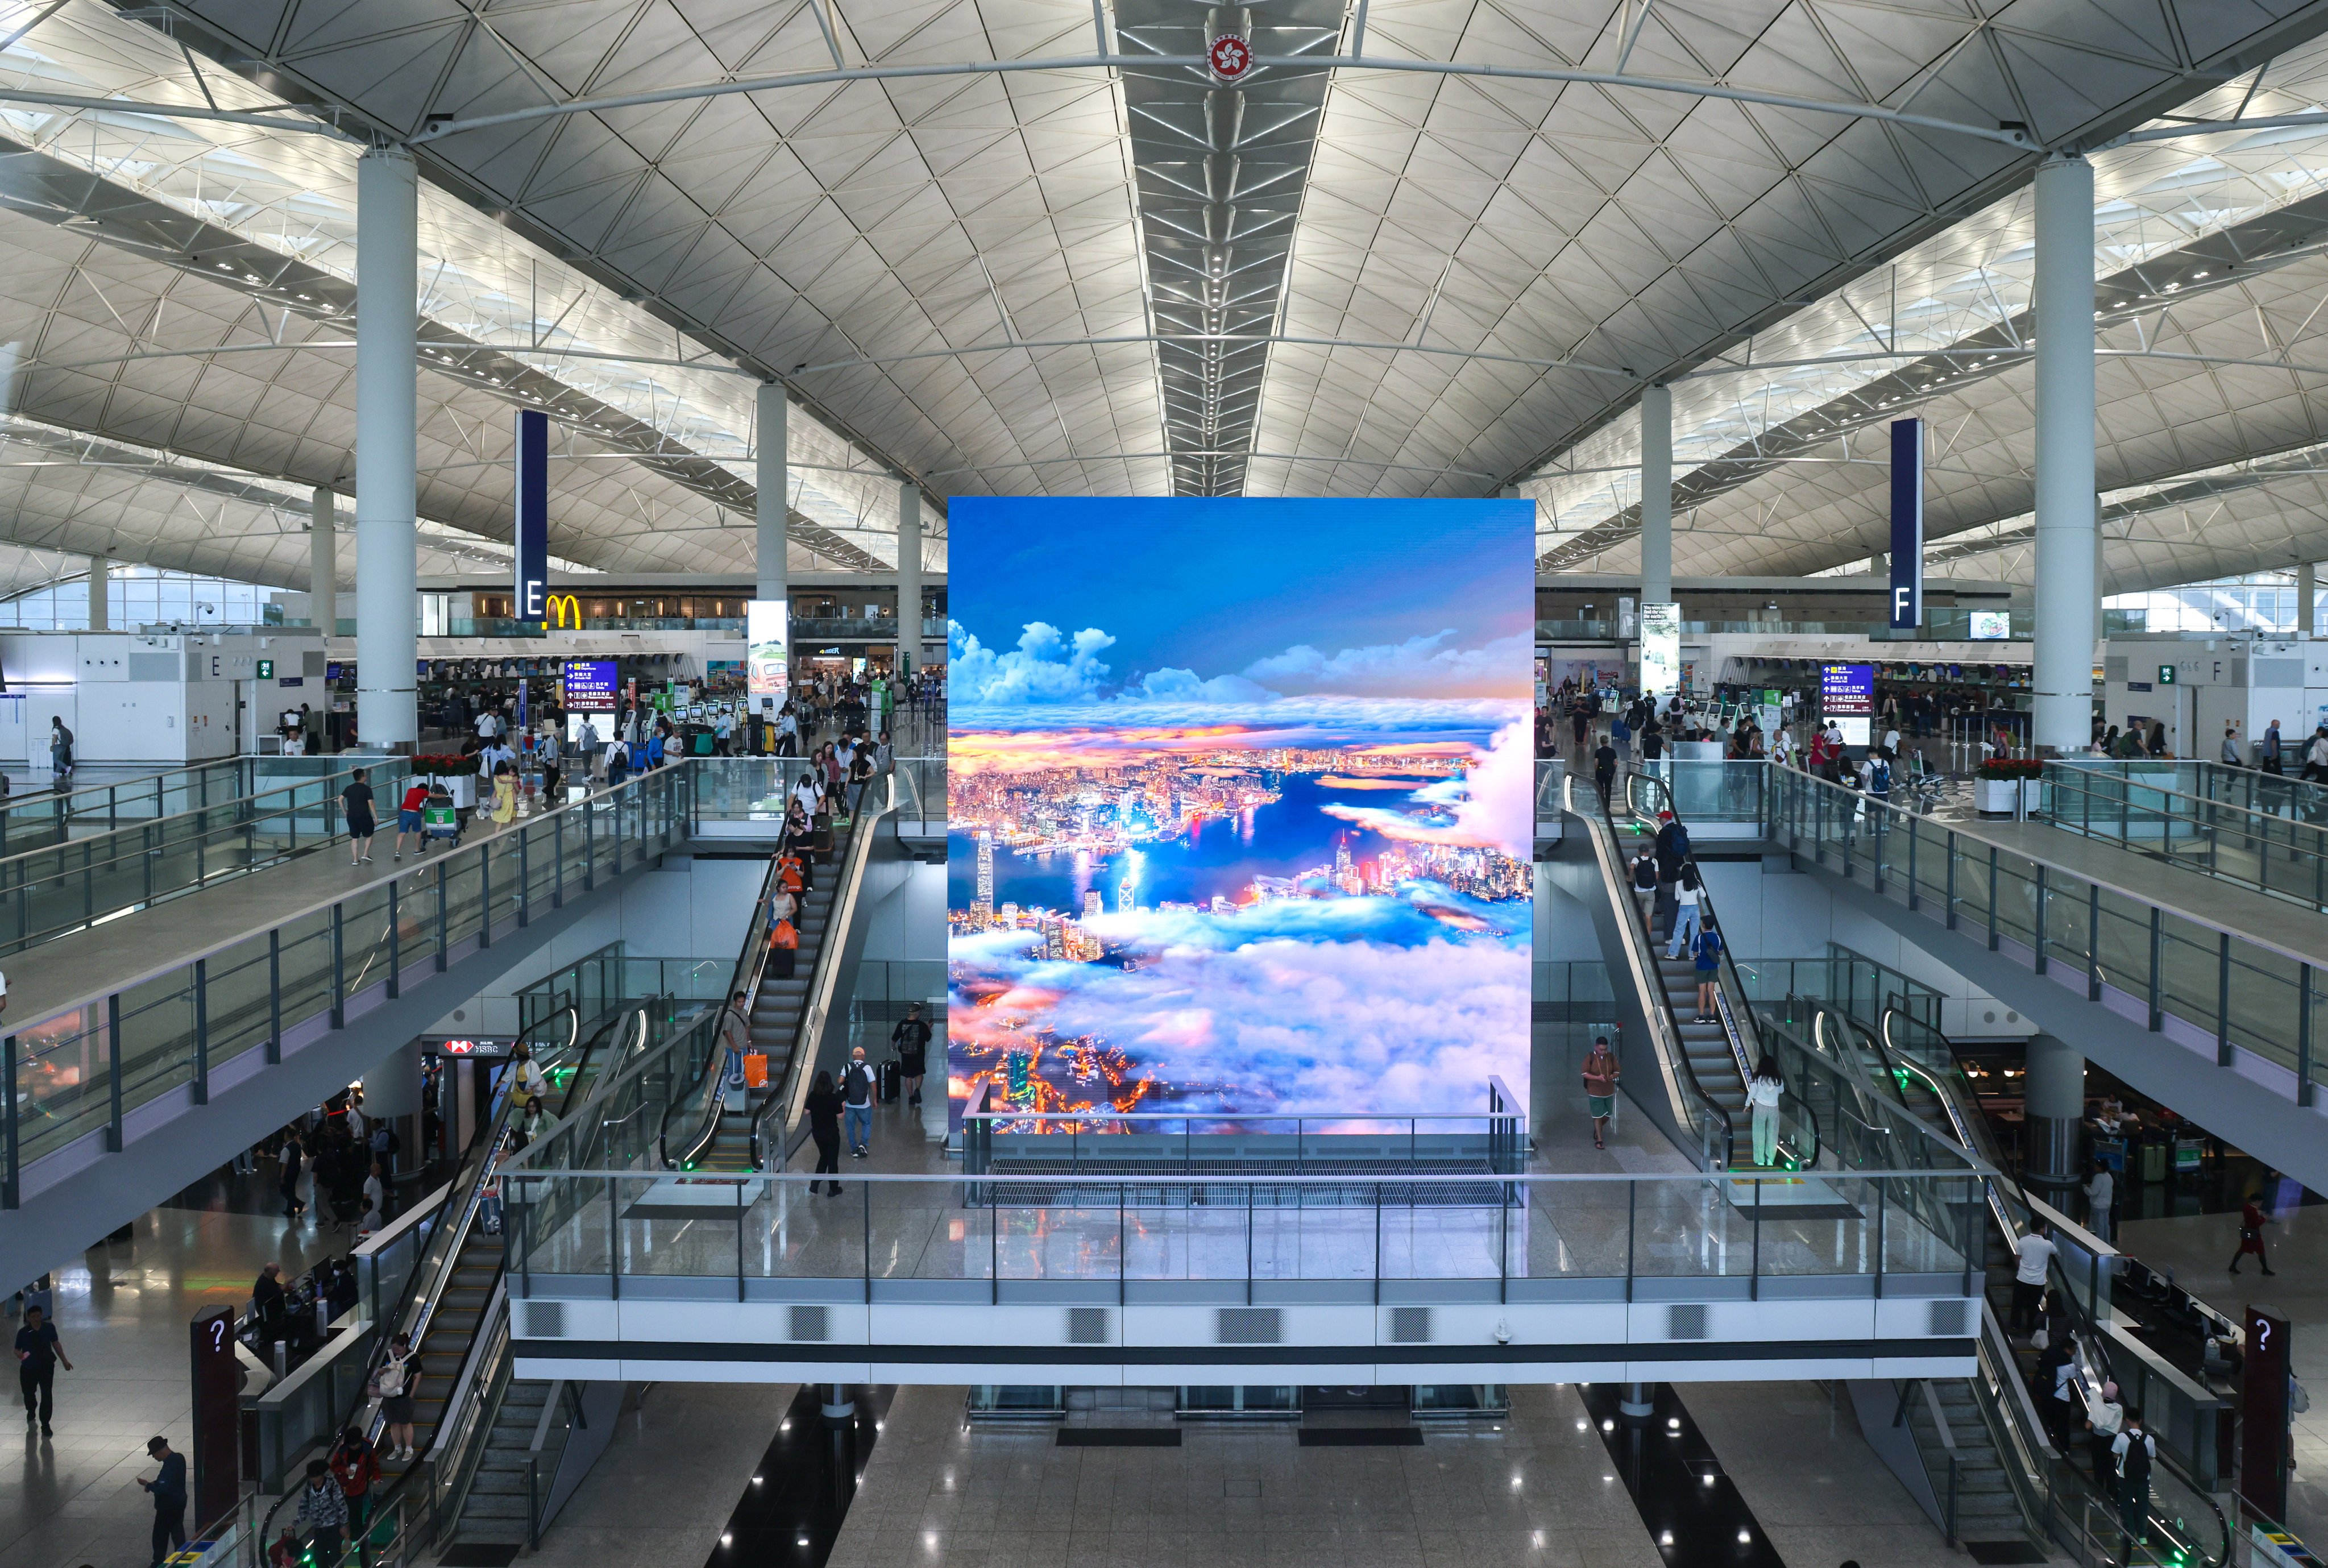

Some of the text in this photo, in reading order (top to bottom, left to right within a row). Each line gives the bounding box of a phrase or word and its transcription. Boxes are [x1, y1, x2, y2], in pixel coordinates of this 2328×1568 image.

[528, 580, 541, 614] E
[1895, 587, 1910, 621] F
[213, 656, 219, 676] E
[2214, 662, 2221, 681] F
[880, 682, 886, 691] 2
[662, 696, 666, 708] 1
[1774, 692, 1779, 703] 1
